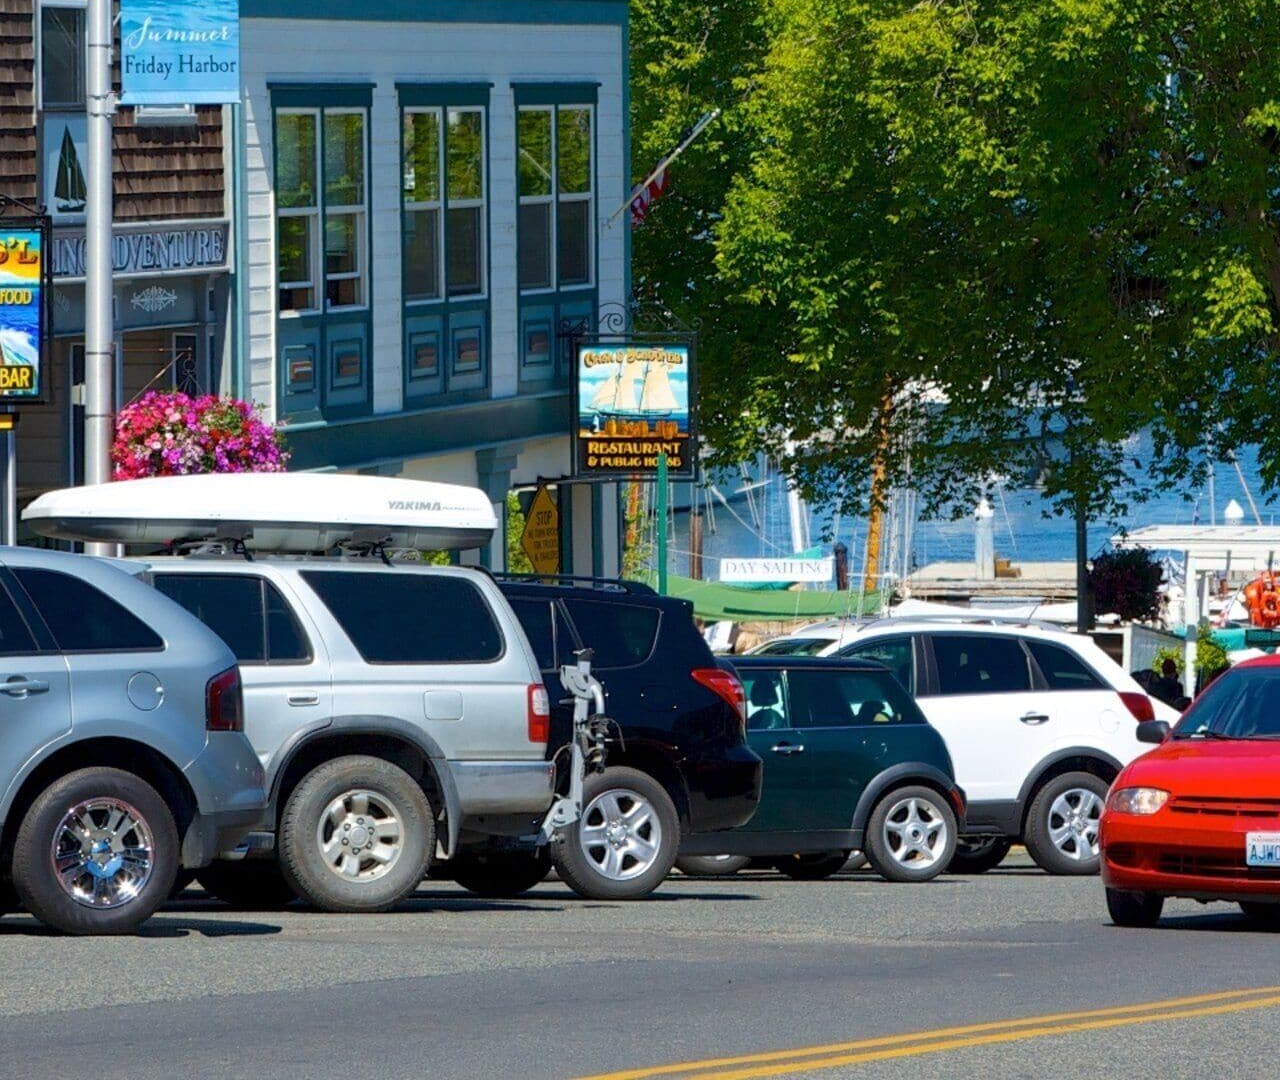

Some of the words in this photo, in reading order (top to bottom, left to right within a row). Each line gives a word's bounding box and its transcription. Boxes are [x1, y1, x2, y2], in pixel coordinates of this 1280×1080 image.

[125, 17, 233, 50] Summer
[125, 56, 173, 81] Friday
[179, 54, 237, 75] Harbor
[112, 229, 223, 270] DVENTURE
[0, 367, 31, 388] BAR
[587, 441, 682, 455] RESTAURANT
[587, 456, 598, 468] &
[600, 456, 641, 467] PUBLIC
[644, 456, 682, 467] HOSE
[388, 500, 441, 512] YAKIMA
[726, 561, 755, 575] DAY
[762, 561, 829, 575] SAILING
